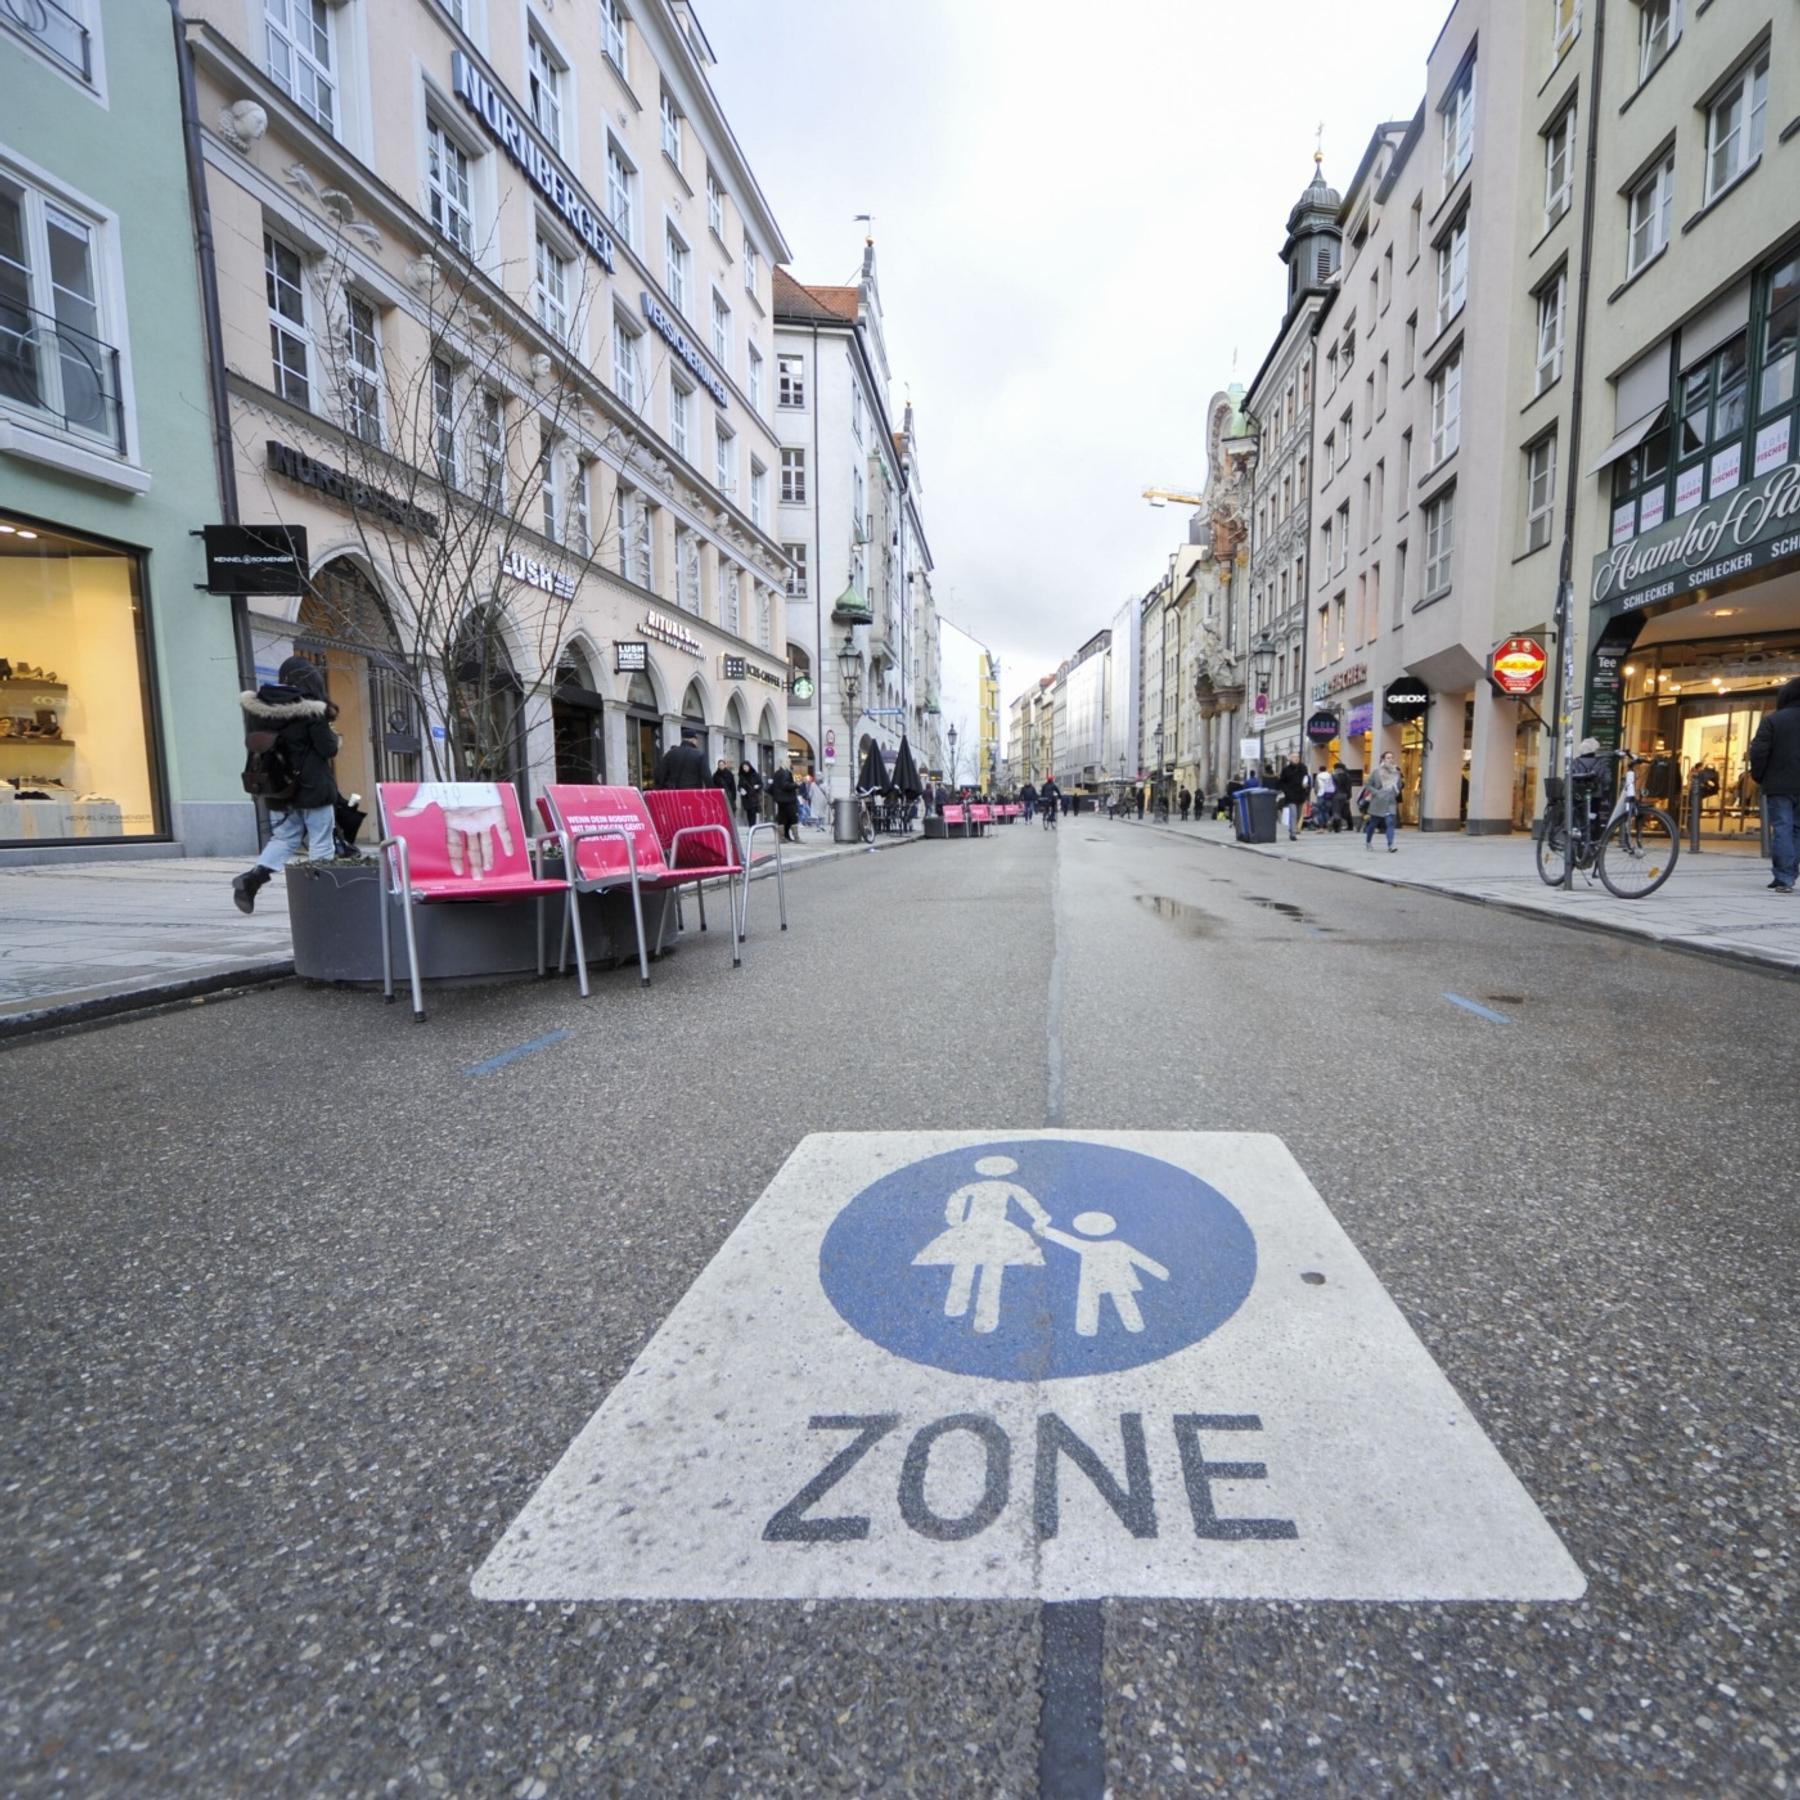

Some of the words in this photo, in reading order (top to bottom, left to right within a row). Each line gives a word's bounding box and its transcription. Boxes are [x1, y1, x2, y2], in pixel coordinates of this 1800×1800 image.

[1757, 441, 1787, 464] FISCHER
[1712, 466, 1739, 486] FISCHER
[1593, 488, 1750, 602] Asamhof
[497, 544, 554, 593] LUSH
[1623, 582, 1674, 610] SCHLECKER
[1689, 553, 1752, 587] SCHLECKER
[1771, 535, 1800, 558] SCH
[618, 644, 645, 653] LUSH
[1599, 656, 1617, 668] Tee
[1387, 694, 1427, 703] GEOX
[761, 1411, 1299, 1541] ZONE
